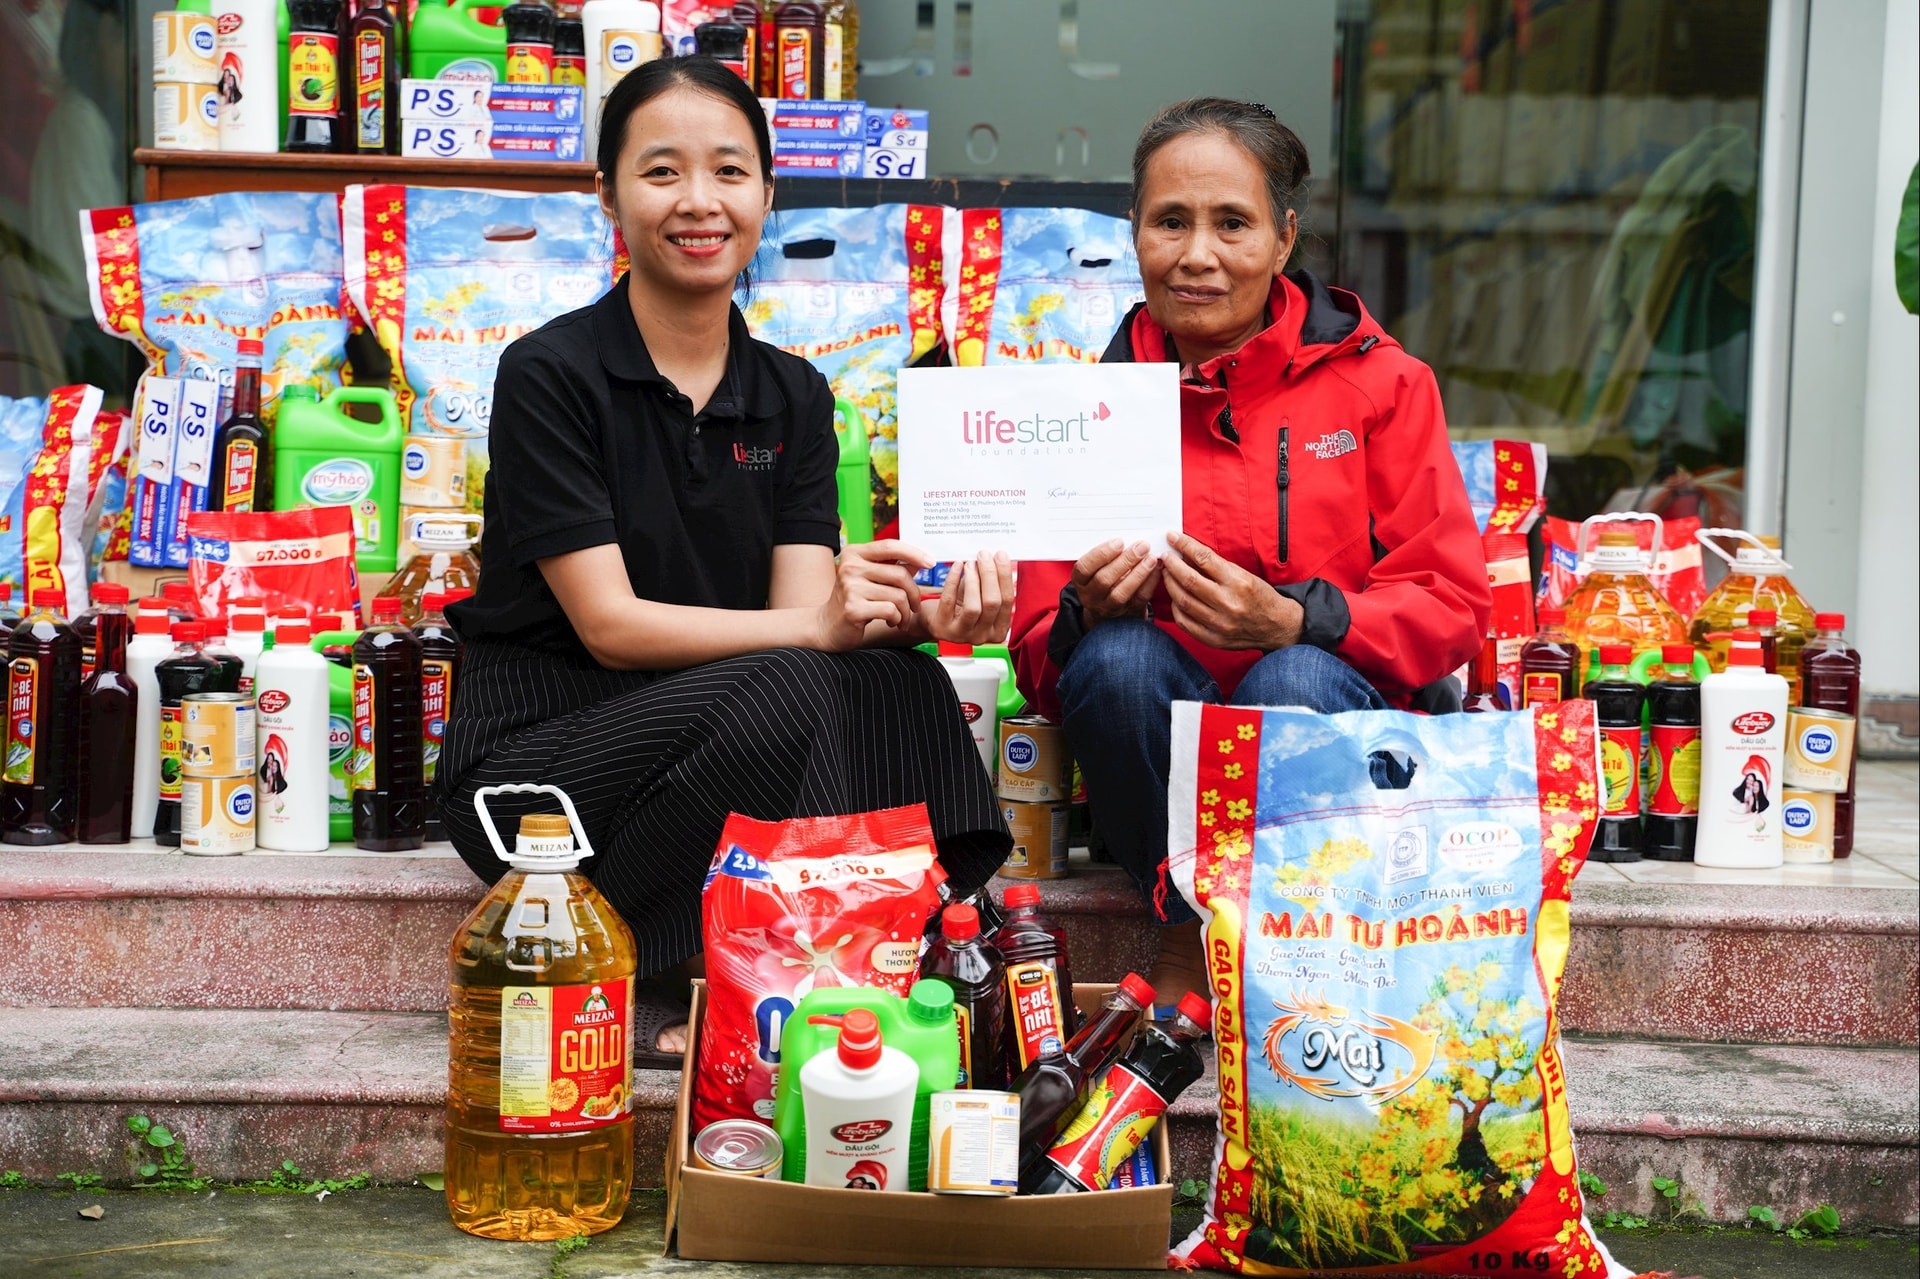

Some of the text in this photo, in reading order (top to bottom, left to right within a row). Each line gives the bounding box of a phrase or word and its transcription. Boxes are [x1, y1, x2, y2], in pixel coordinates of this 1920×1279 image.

[530, 101, 550, 111] 10X
[814, 118, 834, 128] 10X
[532, 140, 551, 150] 10X
[814, 157, 834, 167] 10X
[413, 326, 464, 344] MAI
[998, 341, 1044, 361] MAI
[446, 391, 491, 430] Ma
[963, 409, 1089, 444] lifestart
[1320, 432, 1339, 443] THE
[969, 446, 1087, 456] foundation
[1305, 440, 1339, 451] NORTH
[1315, 449, 1341, 459] FACE
[923, 489, 1026, 498] LIFESTART FOUNDATION
[1734, 719, 1771, 729] Lifebuoy
[1808, 737, 1831, 746] DUTCH
[1810, 743, 1828, 751] LADY
[1787, 811, 1809, 820] DUTCH
[1789, 817, 1806, 825] LADY
[1450, 829, 1508, 846] OCOP
[530, 844, 569, 852] MEIZAN
[732, 853, 756, 872] 2,9
[1281, 885, 1325, 897] CÔNG
[1331, 887, 1349, 898] TY
[1477, 882, 1513, 897] VIÊN
[1259, 904, 1528, 950] MAI TƯ HOẢNH
[1213, 938, 1233, 998] GẠO
[574, 1010, 615, 1025] MEIZAN
[1217, 1005, 1239, 1067] ĐẶC
[560, 1024, 622, 1073] GOLD
[1302, 1027, 1383, 1083] Mai
[838, 1126, 886, 1135] Lifebuoy
[864, 1143, 880, 1151] GỘI
[1468, 1251, 1550, 1273] 10 Kg
